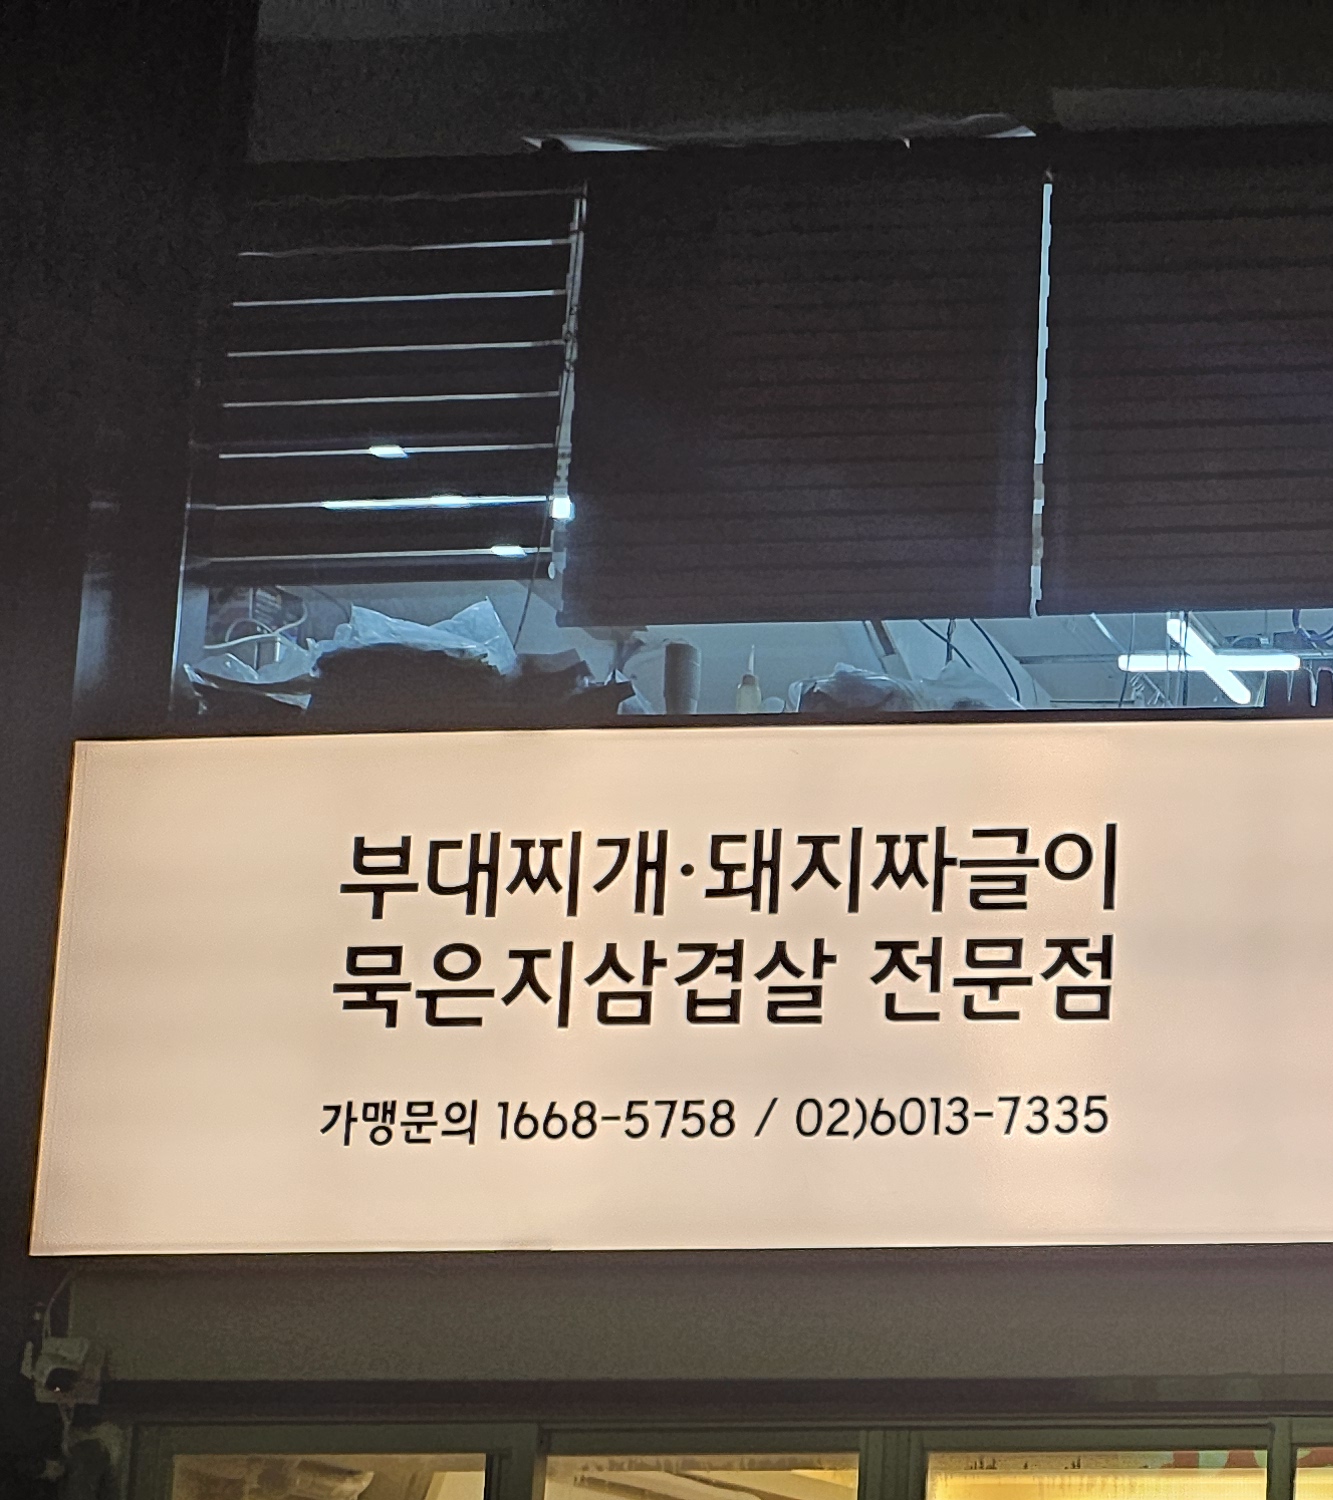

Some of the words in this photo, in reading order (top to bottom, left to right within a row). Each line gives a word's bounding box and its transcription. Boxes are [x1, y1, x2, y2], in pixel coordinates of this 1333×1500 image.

[340, 824, 1117, 919] 부대찌개·돼지짜글이
[333, 938, 837, 1028] 묵은지삼겹살
[870, 935, 1114, 1022] 전문점
[320, 1099, 478, 1147] 가맹문의
[497, 1099, 736, 1140] 1668-5758
[796, 1095, 1108, 1140] 02)6013-7335
